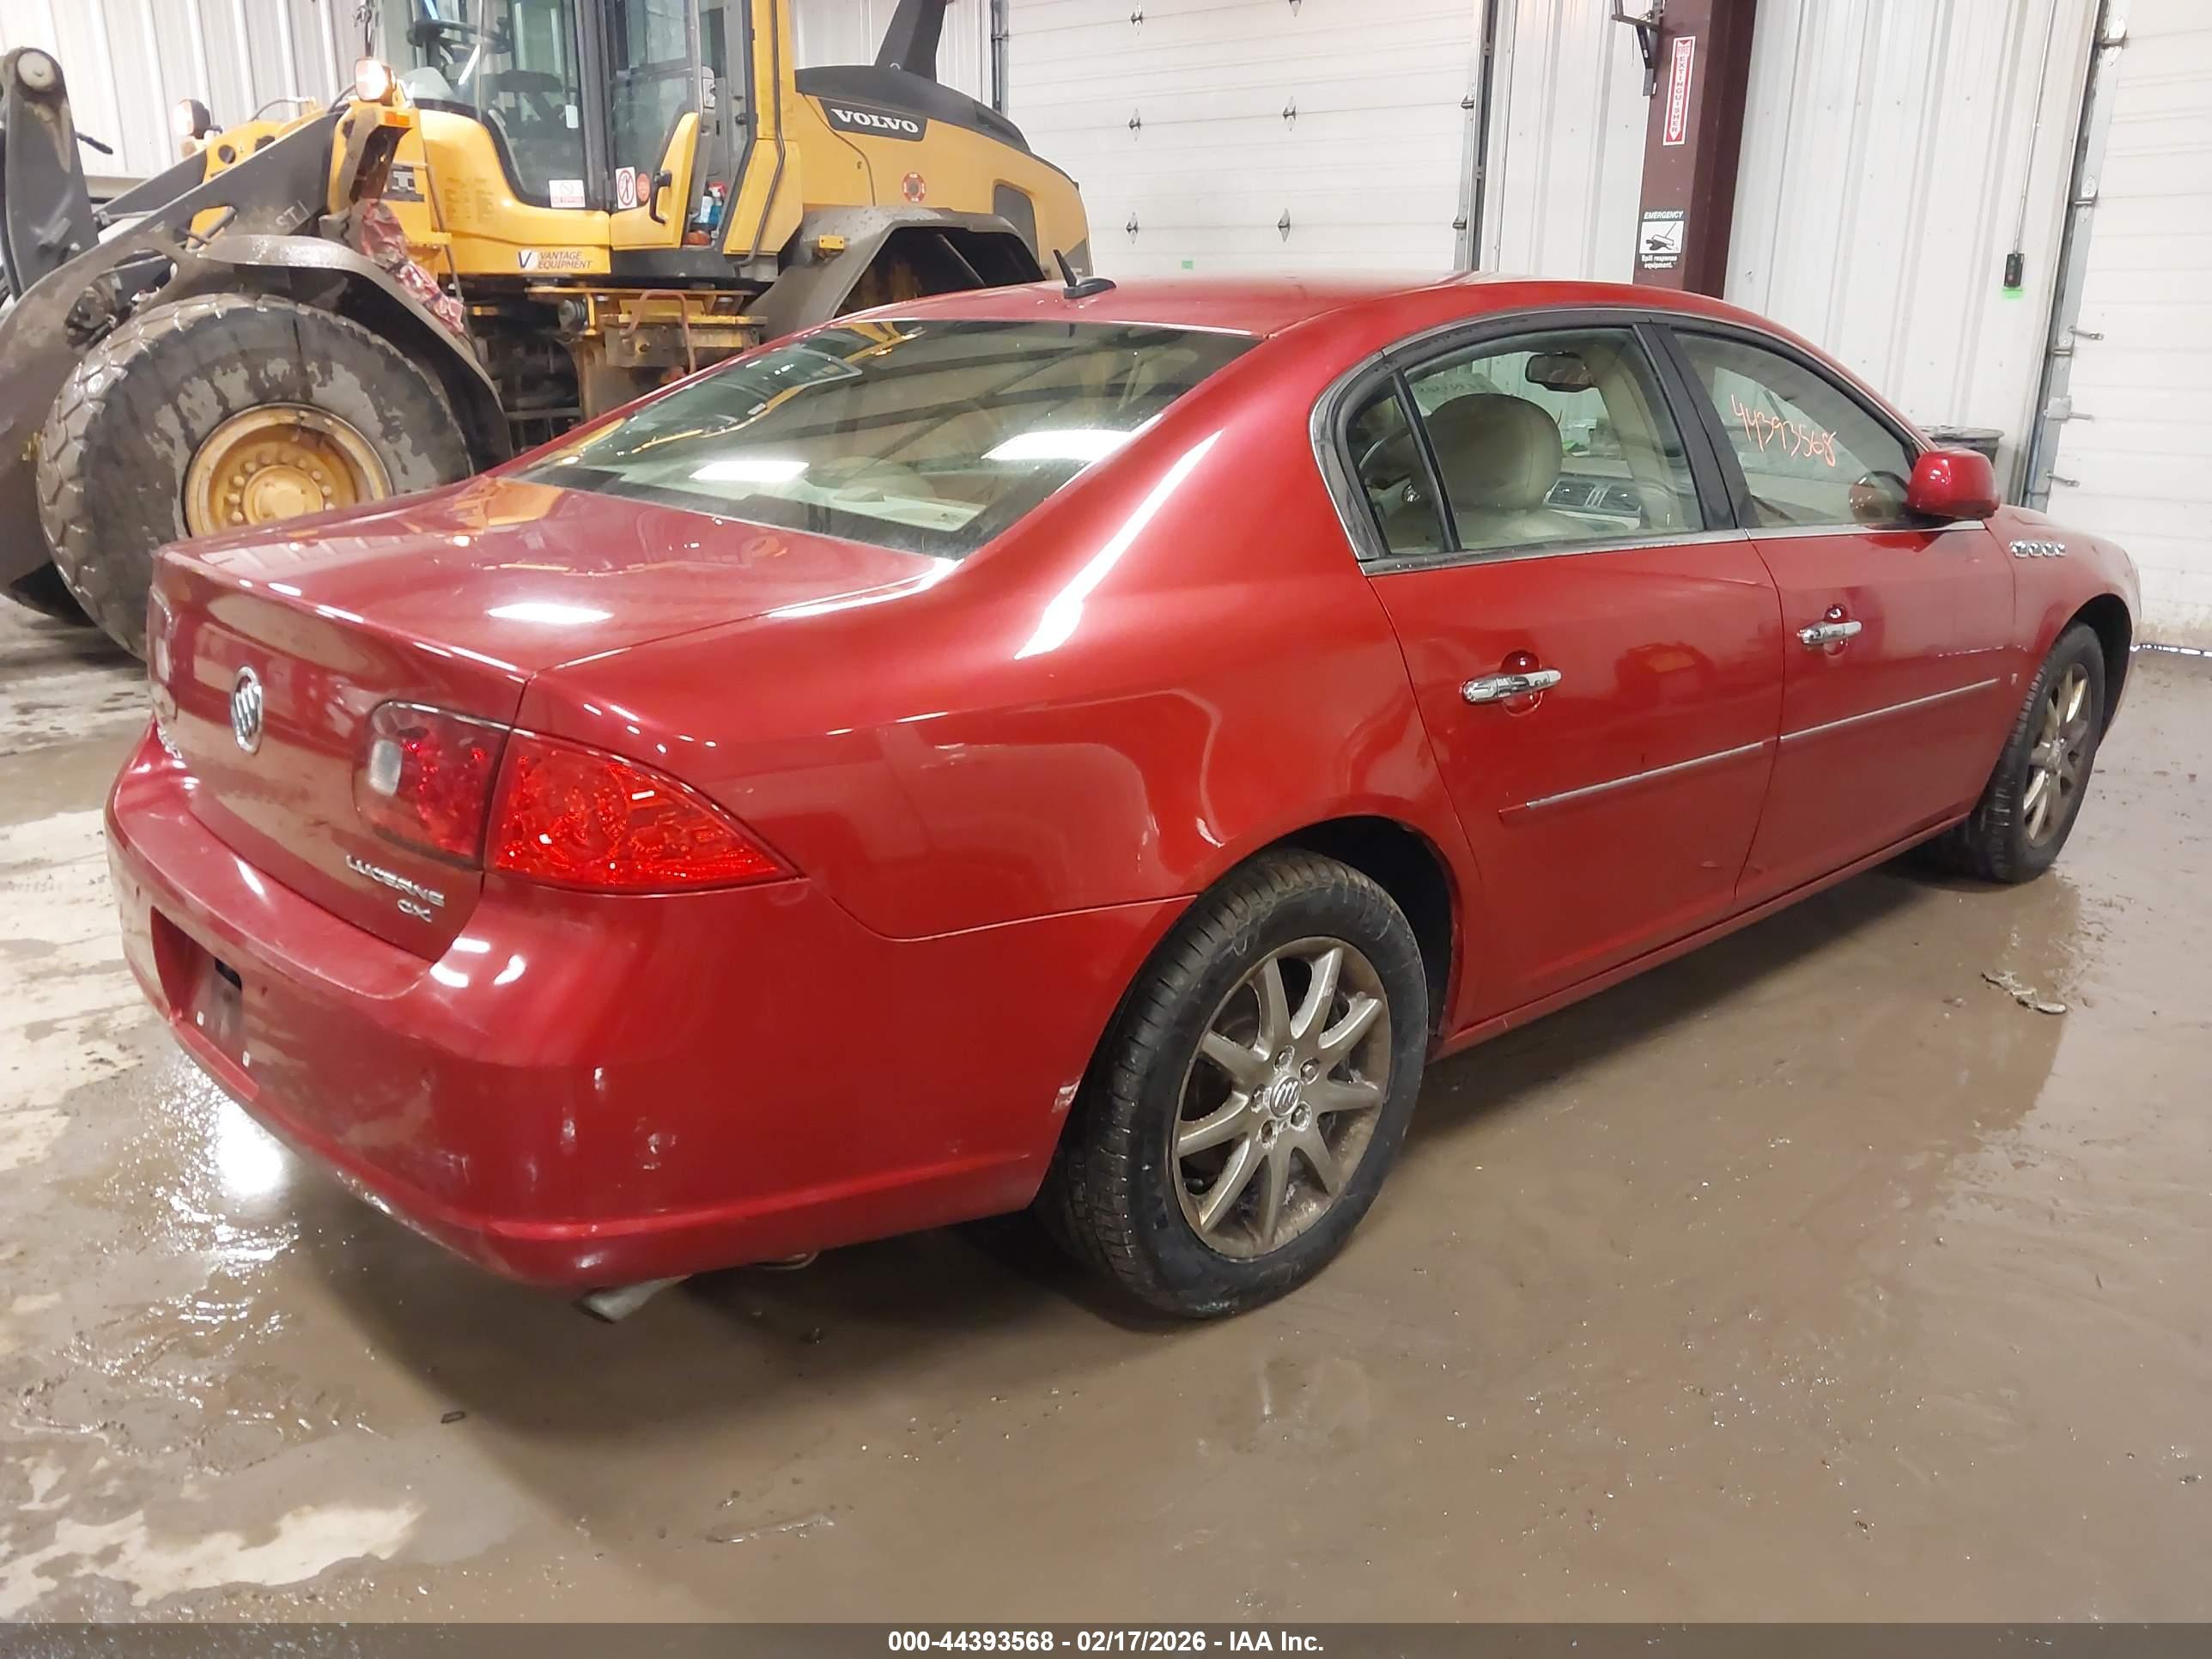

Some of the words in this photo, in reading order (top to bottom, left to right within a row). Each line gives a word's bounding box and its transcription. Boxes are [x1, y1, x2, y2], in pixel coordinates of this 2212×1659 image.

[1671, 56, 1685, 132] EXTINGUISHER
[830, 108, 919, 133] VOLVO
[1644, 210, 1684, 220] EMERGENCY
[538, 260, 592, 270] EQUIPMENT
[540, 251, 583, 260] VANTAGE
[1731, 394, 1837, 467] 44393568
[346, 854, 445, 907] LUCERNE
[398, 899, 432, 923] CX
